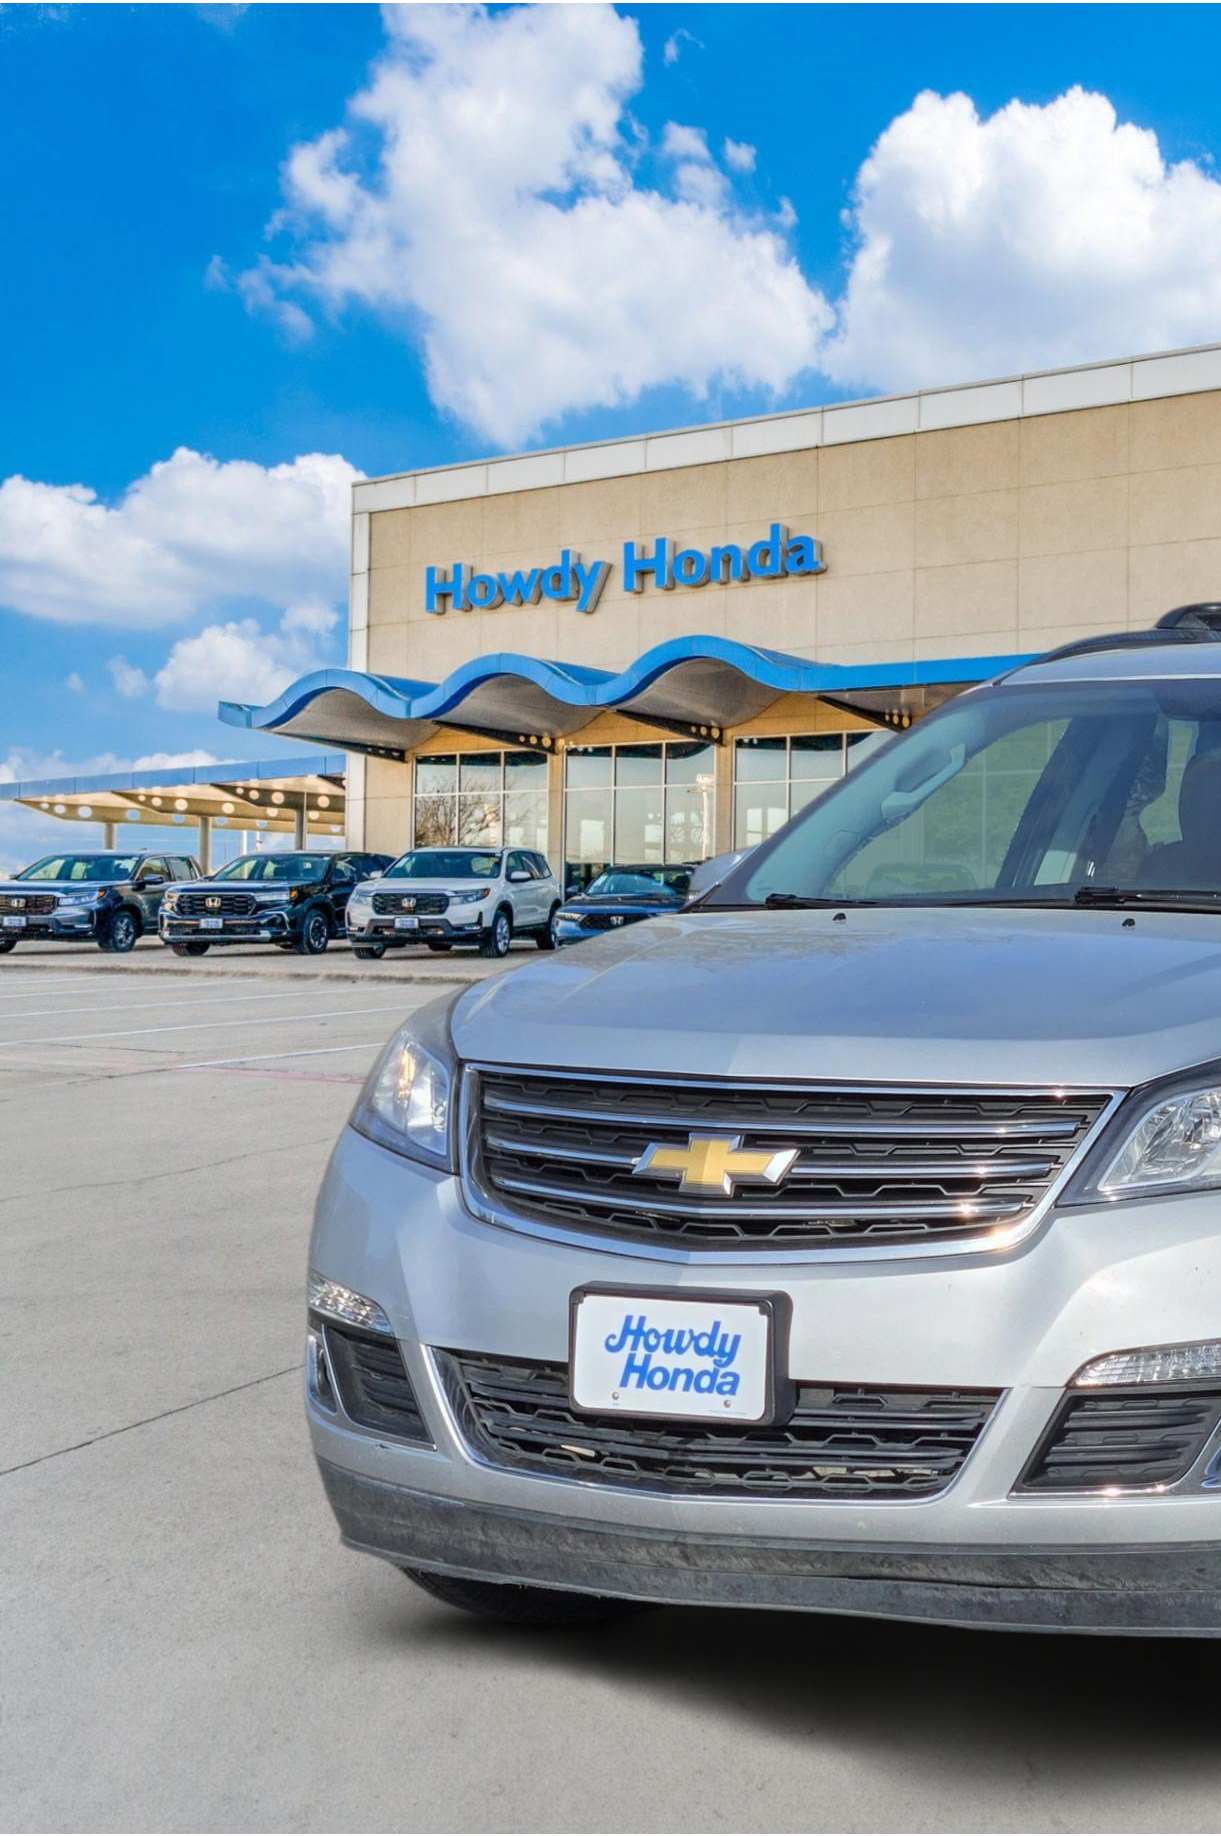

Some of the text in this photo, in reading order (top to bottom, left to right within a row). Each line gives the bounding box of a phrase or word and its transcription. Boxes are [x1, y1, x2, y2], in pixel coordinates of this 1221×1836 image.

[424, 522, 828, 615] Howdy Honda
[604, 1314, 742, 1368] Howdy
[619, 1353, 741, 1396] Honda
